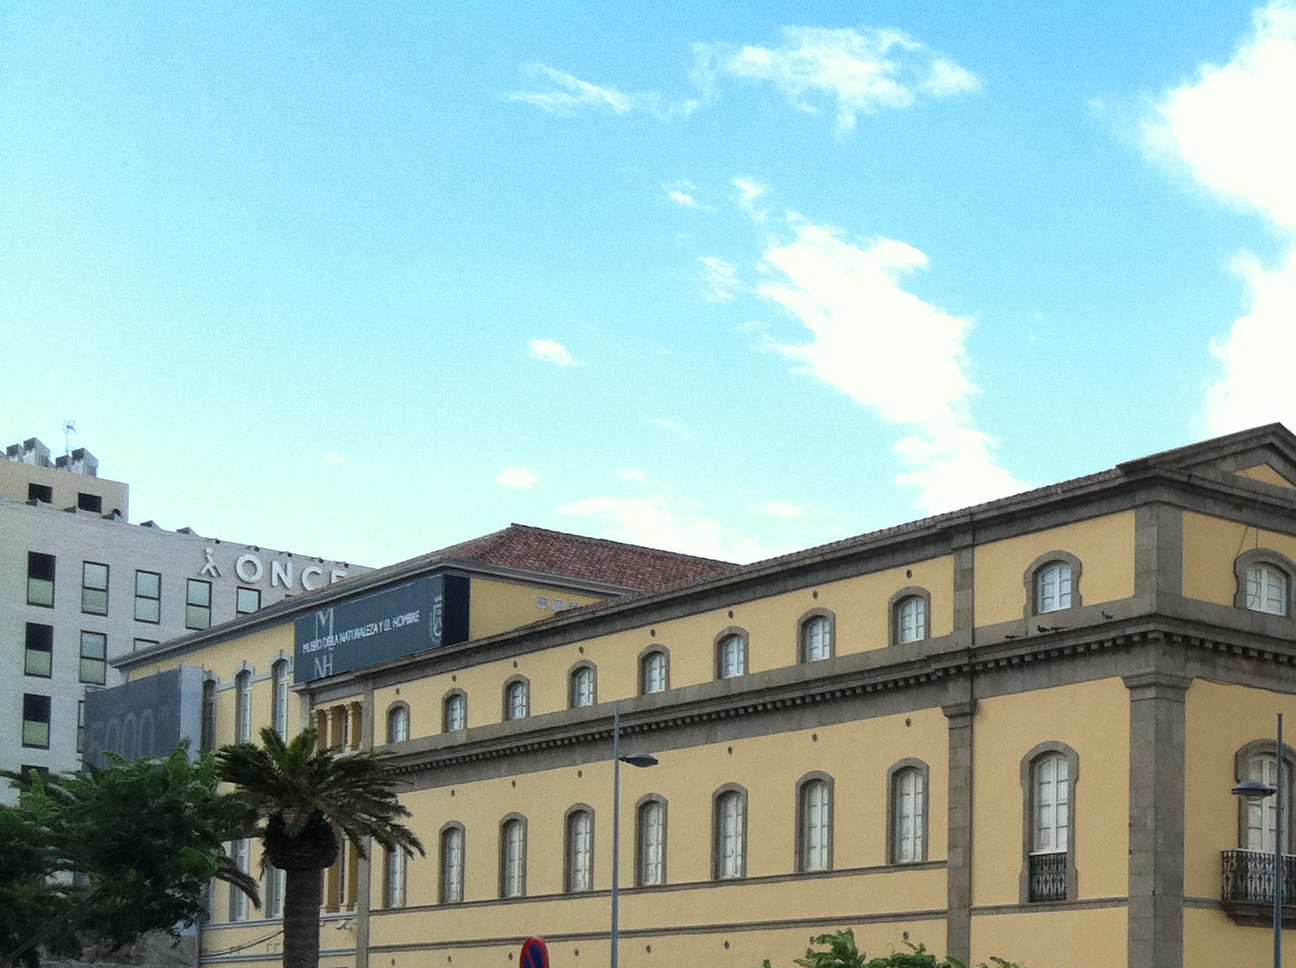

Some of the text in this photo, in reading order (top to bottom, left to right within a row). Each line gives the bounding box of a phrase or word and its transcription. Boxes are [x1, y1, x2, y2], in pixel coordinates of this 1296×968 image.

[302, 638, 322, 654] MUSEO
[339, 623, 379, 643] NATURALEZA
[378, 620, 385, 633] Y
[384, 618, 392, 632] EL
[392, 610, 421, 628] HOMBRE
